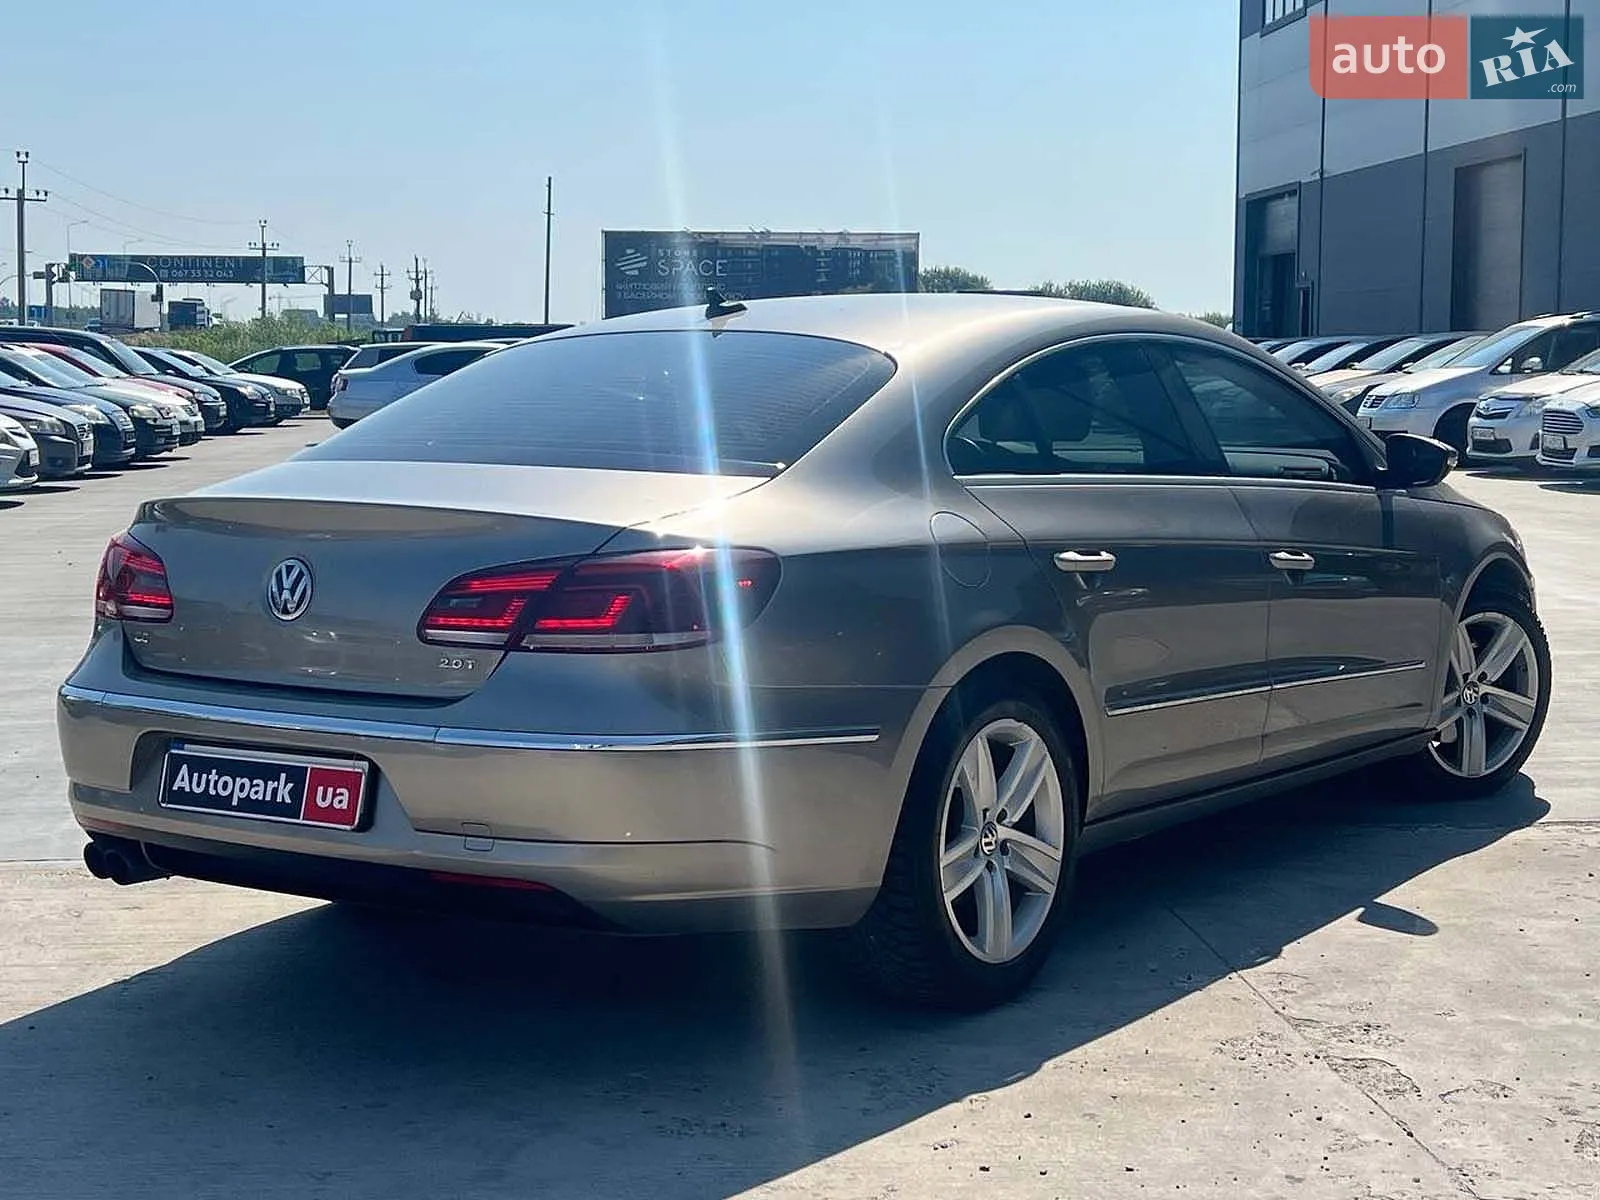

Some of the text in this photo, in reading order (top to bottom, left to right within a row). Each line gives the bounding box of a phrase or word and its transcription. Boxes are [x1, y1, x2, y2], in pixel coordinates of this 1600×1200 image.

[657, 259, 728, 276] SPACE
[171, 763, 350, 810] Autopark ua
